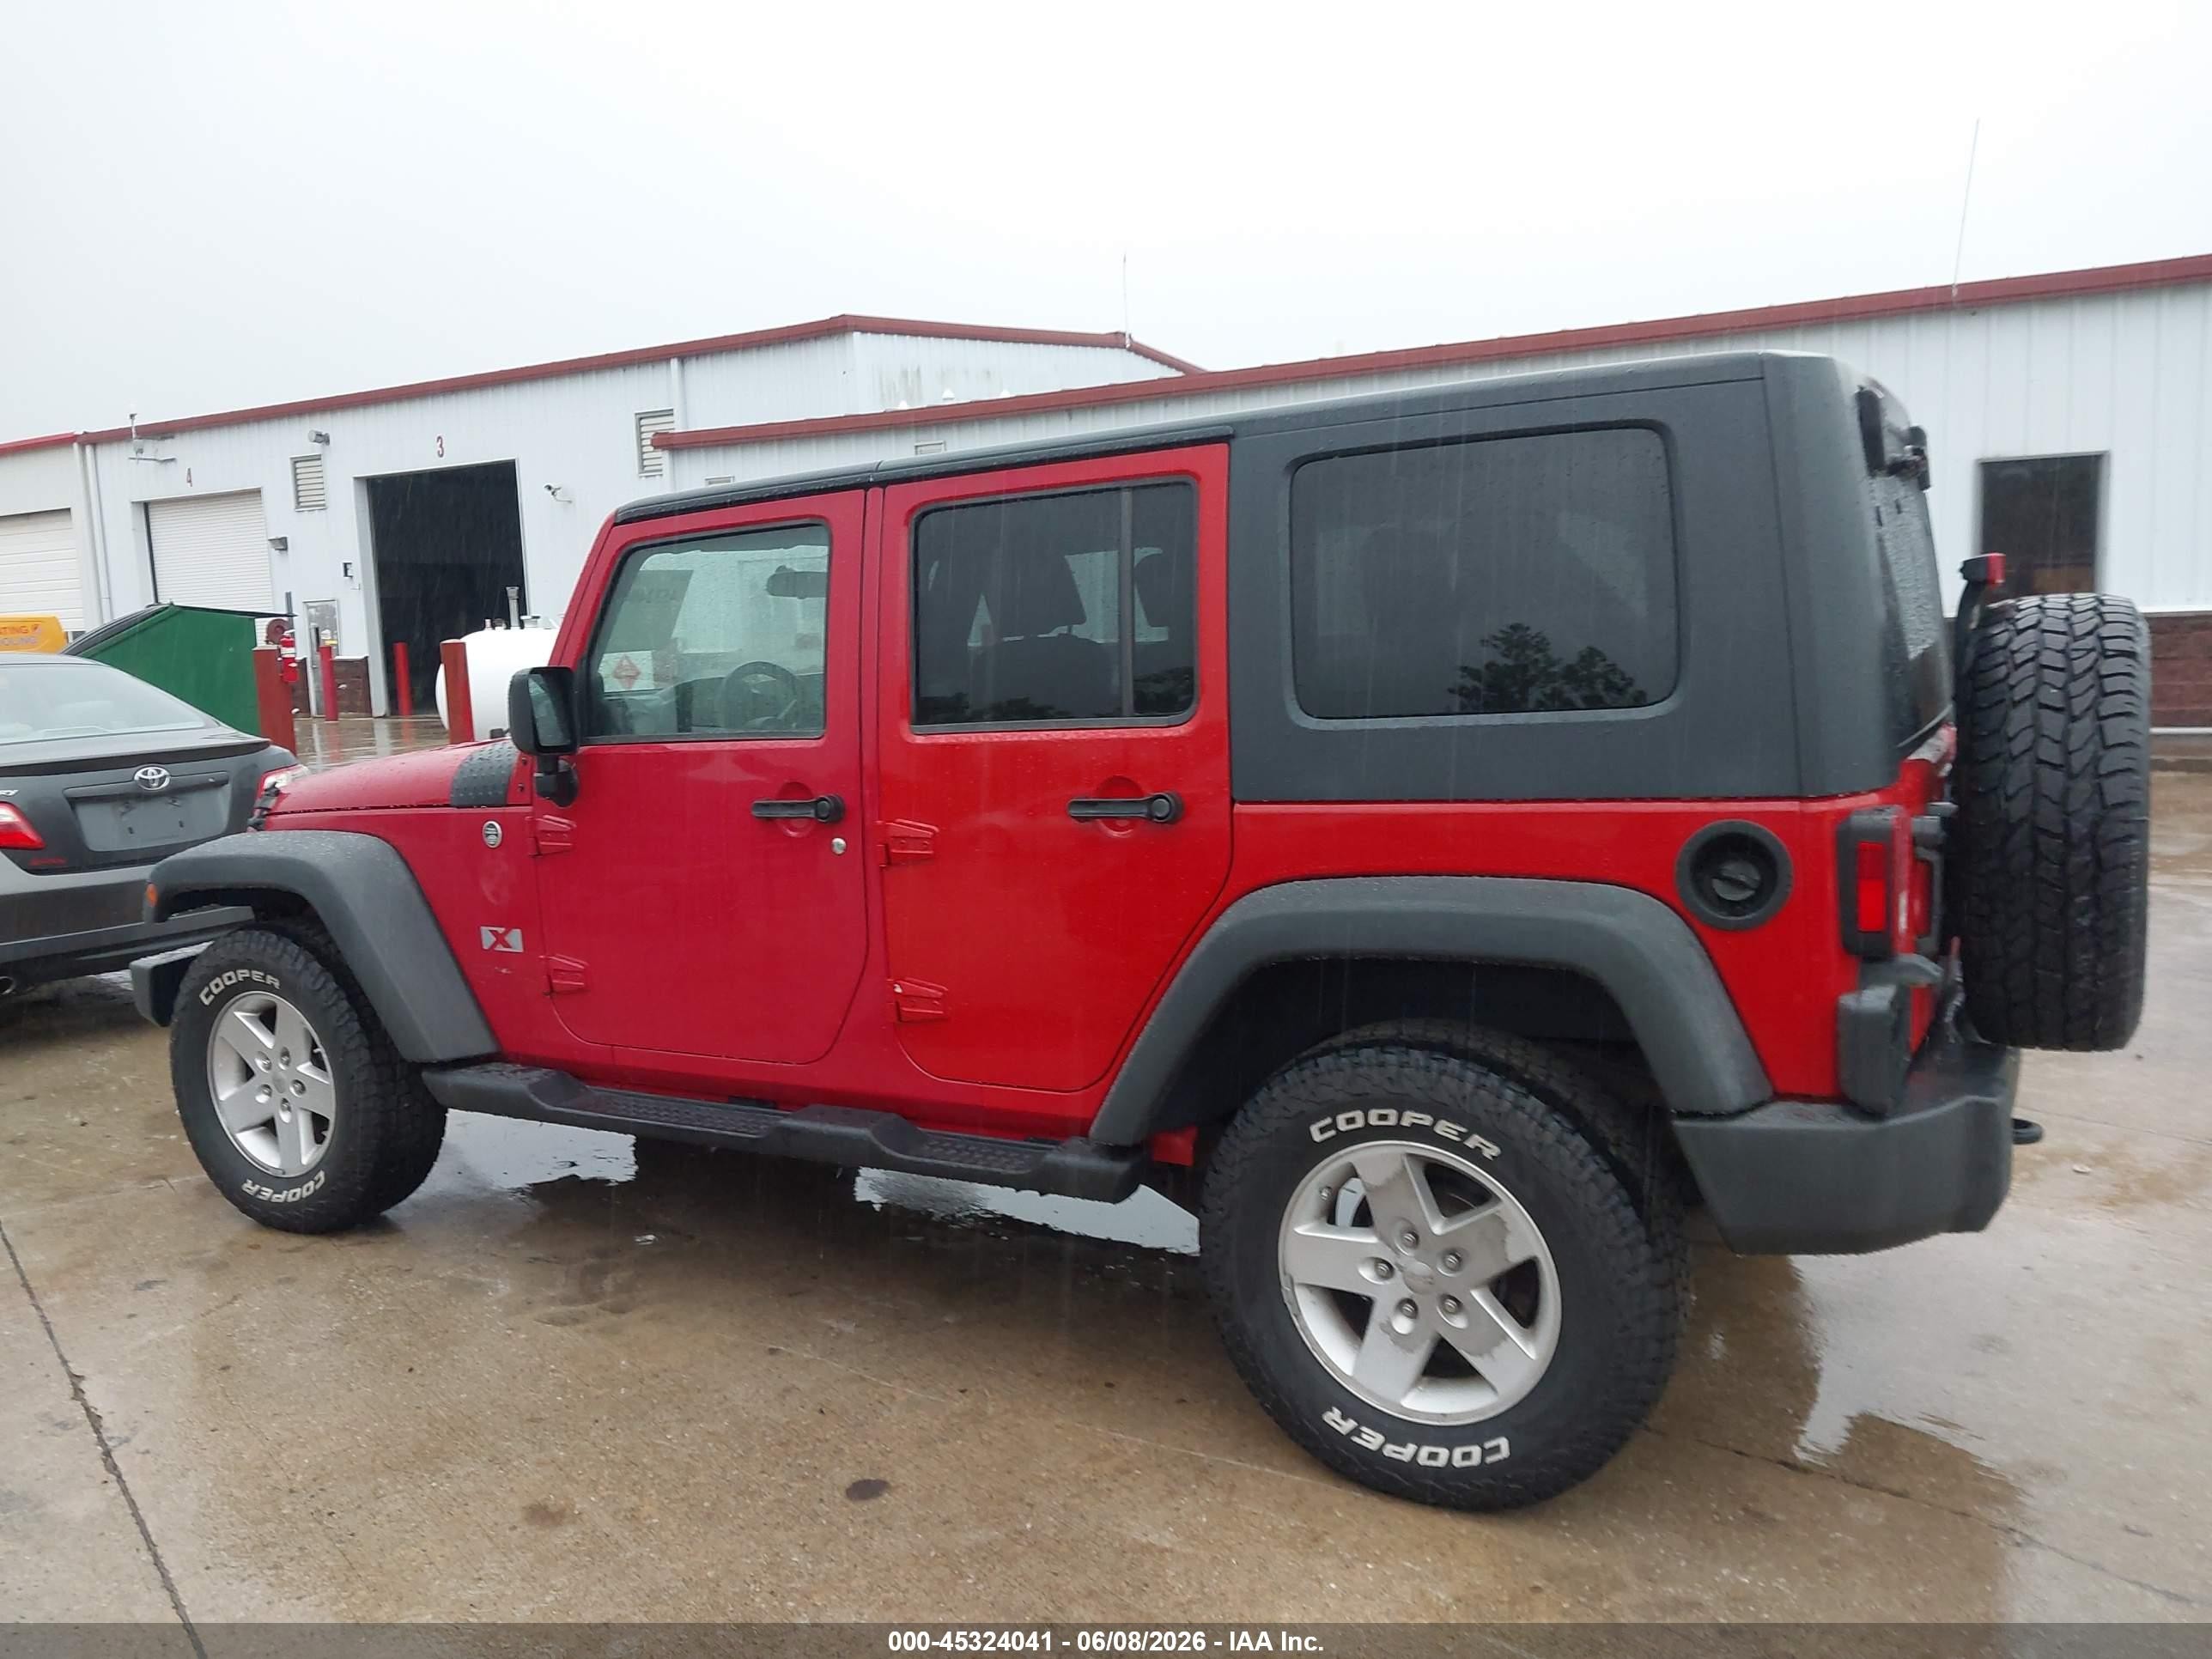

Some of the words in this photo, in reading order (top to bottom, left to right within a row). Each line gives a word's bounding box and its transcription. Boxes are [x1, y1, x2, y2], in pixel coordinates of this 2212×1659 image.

[436, 435, 444, 458] 3
[186, 468, 192, 487] 4
[199, 969, 281, 1006] COOPER
[1310, 1109, 1501, 1160] COOPER
[241, 1170, 325, 1202] COOPER
[1322, 1407, 1510, 1468] COOPER
